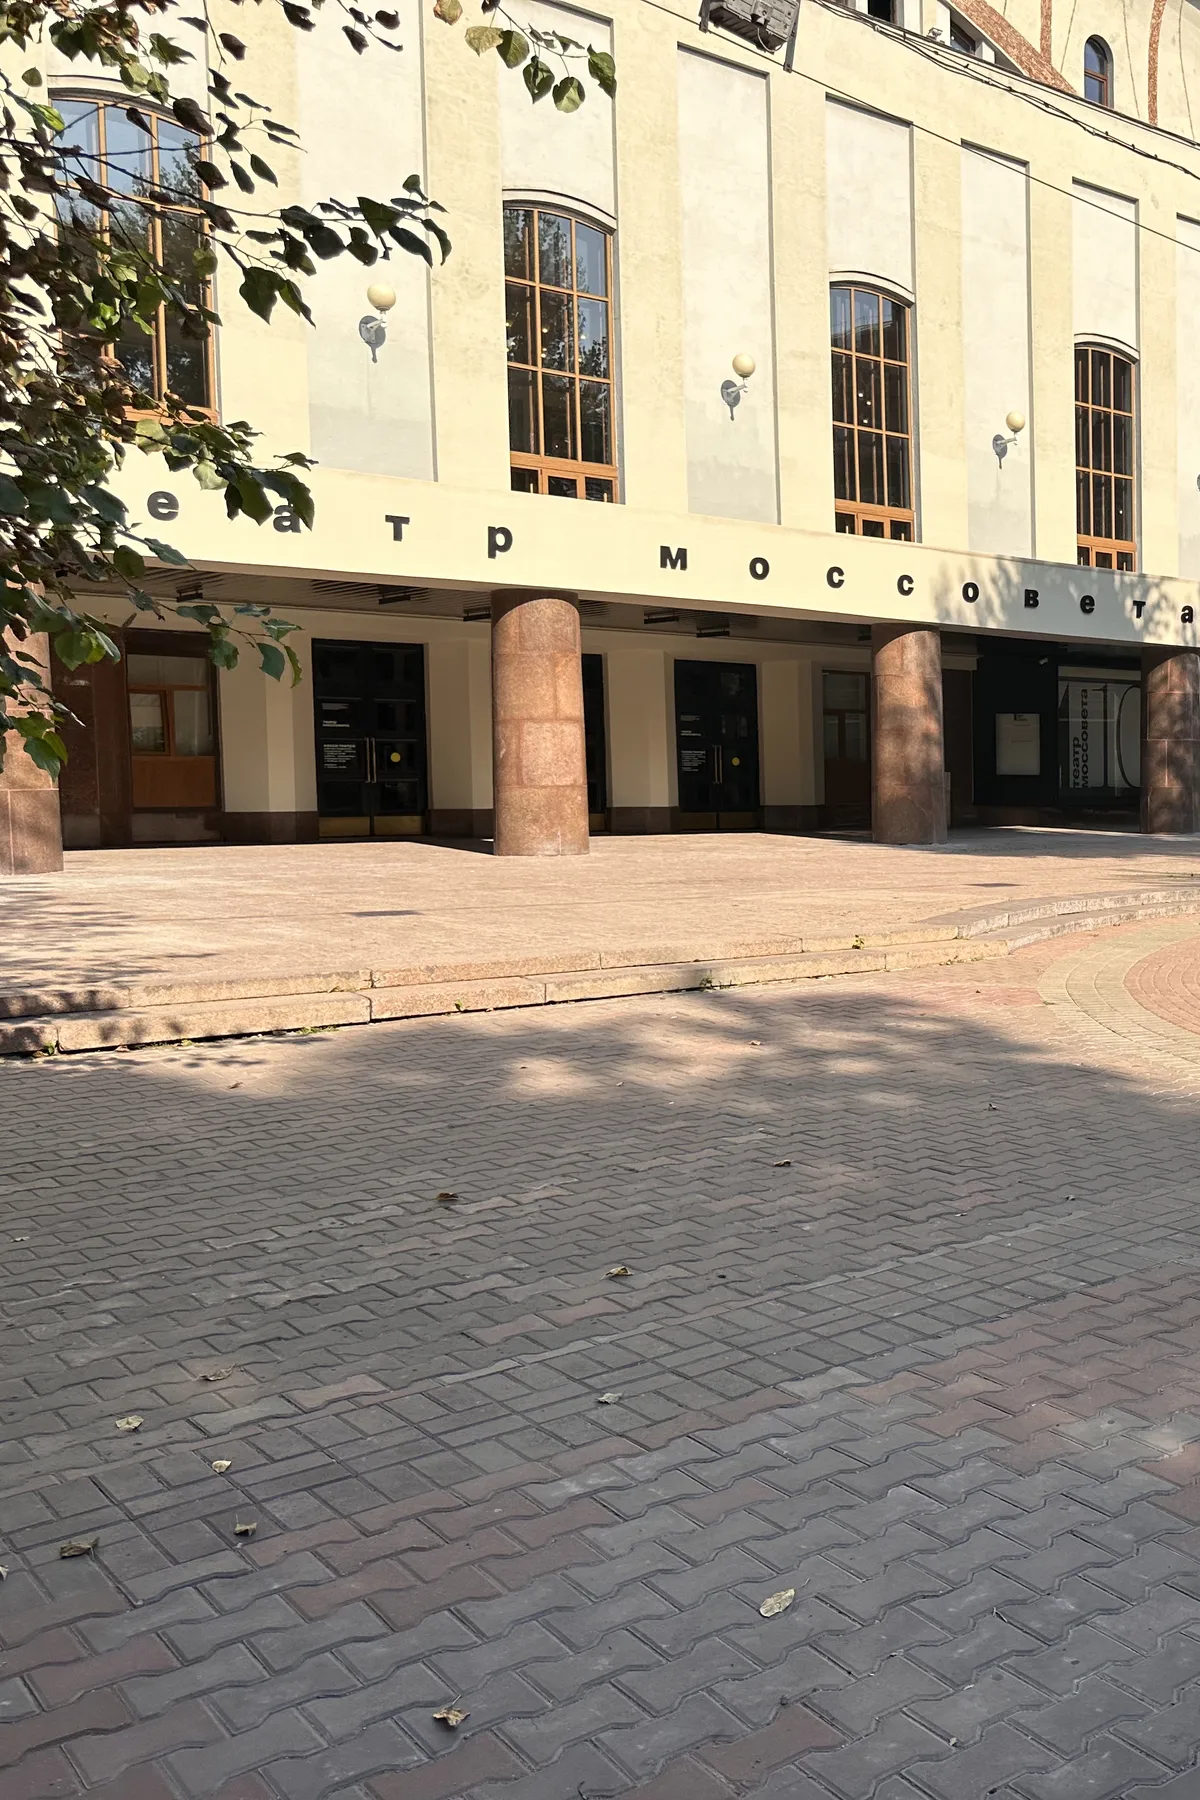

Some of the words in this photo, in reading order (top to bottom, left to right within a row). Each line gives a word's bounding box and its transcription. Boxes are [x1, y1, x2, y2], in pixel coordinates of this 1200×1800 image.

[146, 490, 514, 559] еатр
[660, 545, 1194, 624] моссовета
[1073, 736, 1082, 788] театр
[1081, 688, 1089, 788] моссовета
